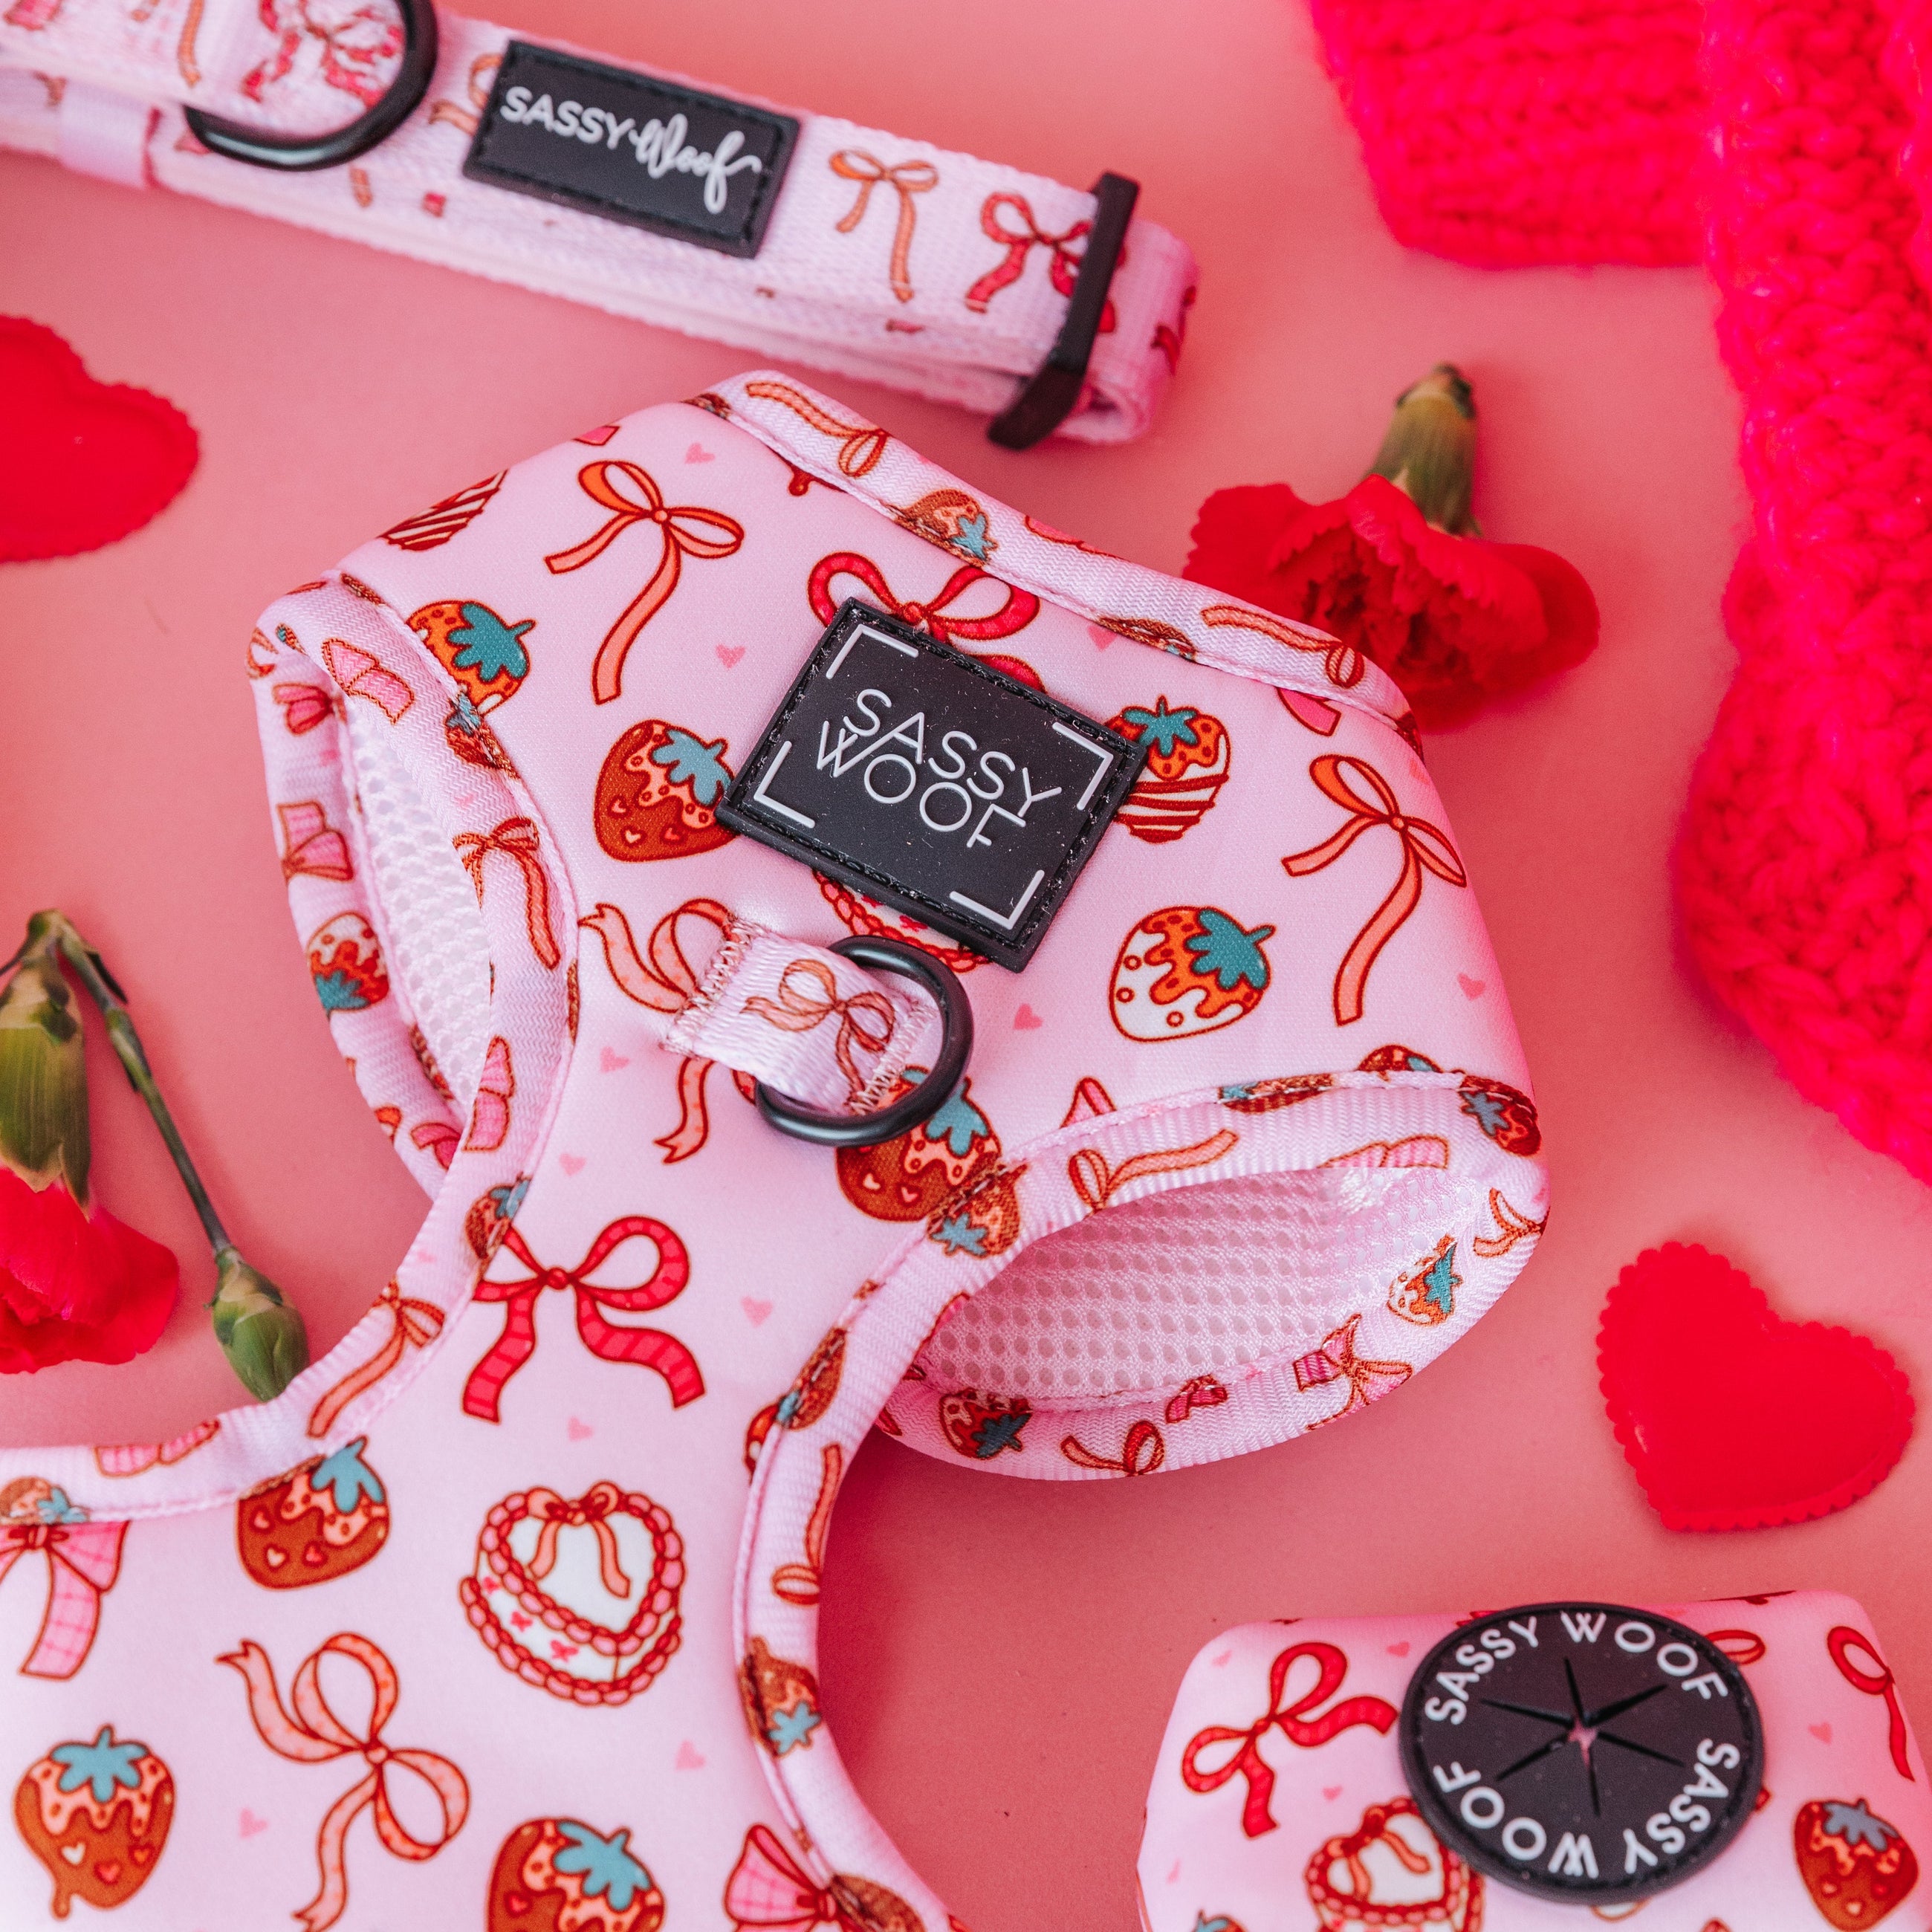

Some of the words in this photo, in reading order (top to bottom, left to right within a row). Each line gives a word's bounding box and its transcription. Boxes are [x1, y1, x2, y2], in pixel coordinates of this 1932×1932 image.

[500, 86, 636, 149] SASSY
[629, 113, 763, 215] Woof
[816, 719, 1027, 849] WOOF
[842, 688, 1063, 818] SASSY
[1424, 1615, 1539, 1725] SASSY
[1560, 1611, 1729, 1700] WOOF
[1432, 1761, 1600, 1879] WOOF
[1623, 1738, 1741, 1875] SASSY
